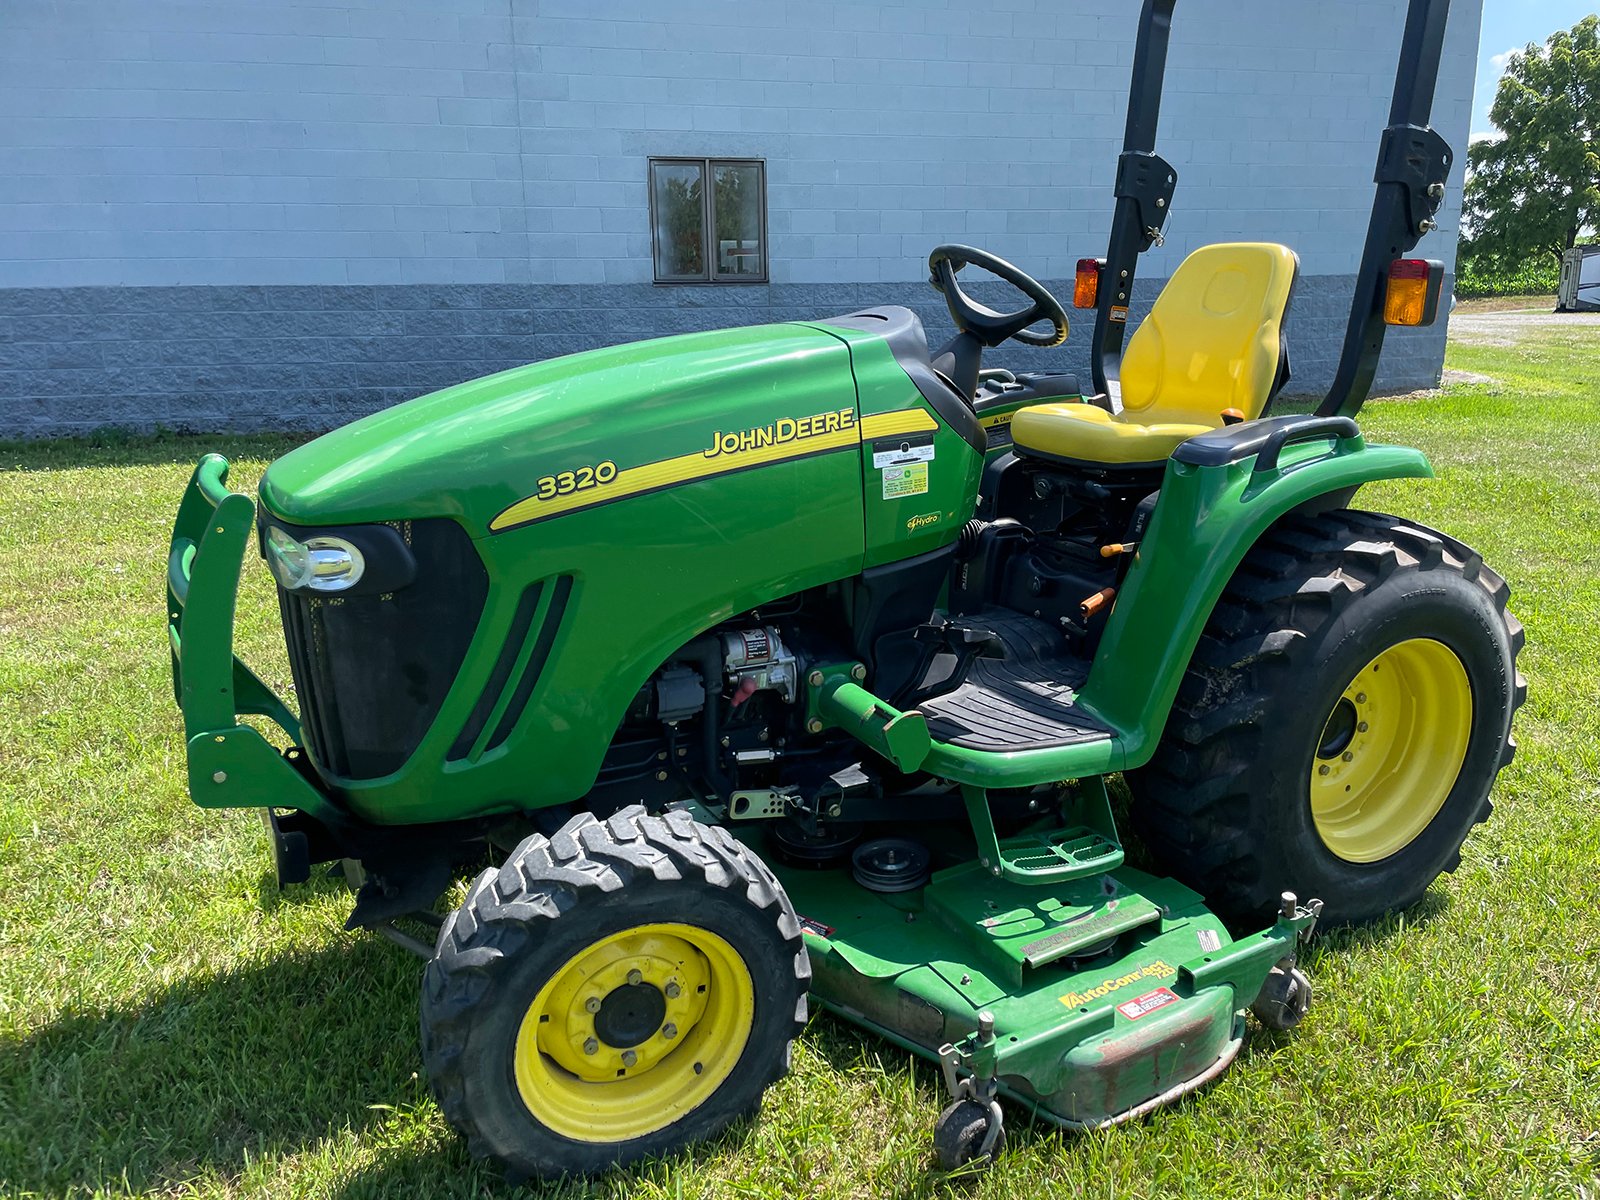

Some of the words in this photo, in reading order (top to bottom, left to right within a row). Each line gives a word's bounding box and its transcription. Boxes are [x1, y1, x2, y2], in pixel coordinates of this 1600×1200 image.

[704, 424, 775, 458] JOHN
[776, 407, 856, 444] DEERE
[536, 460, 618, 500] 3320
